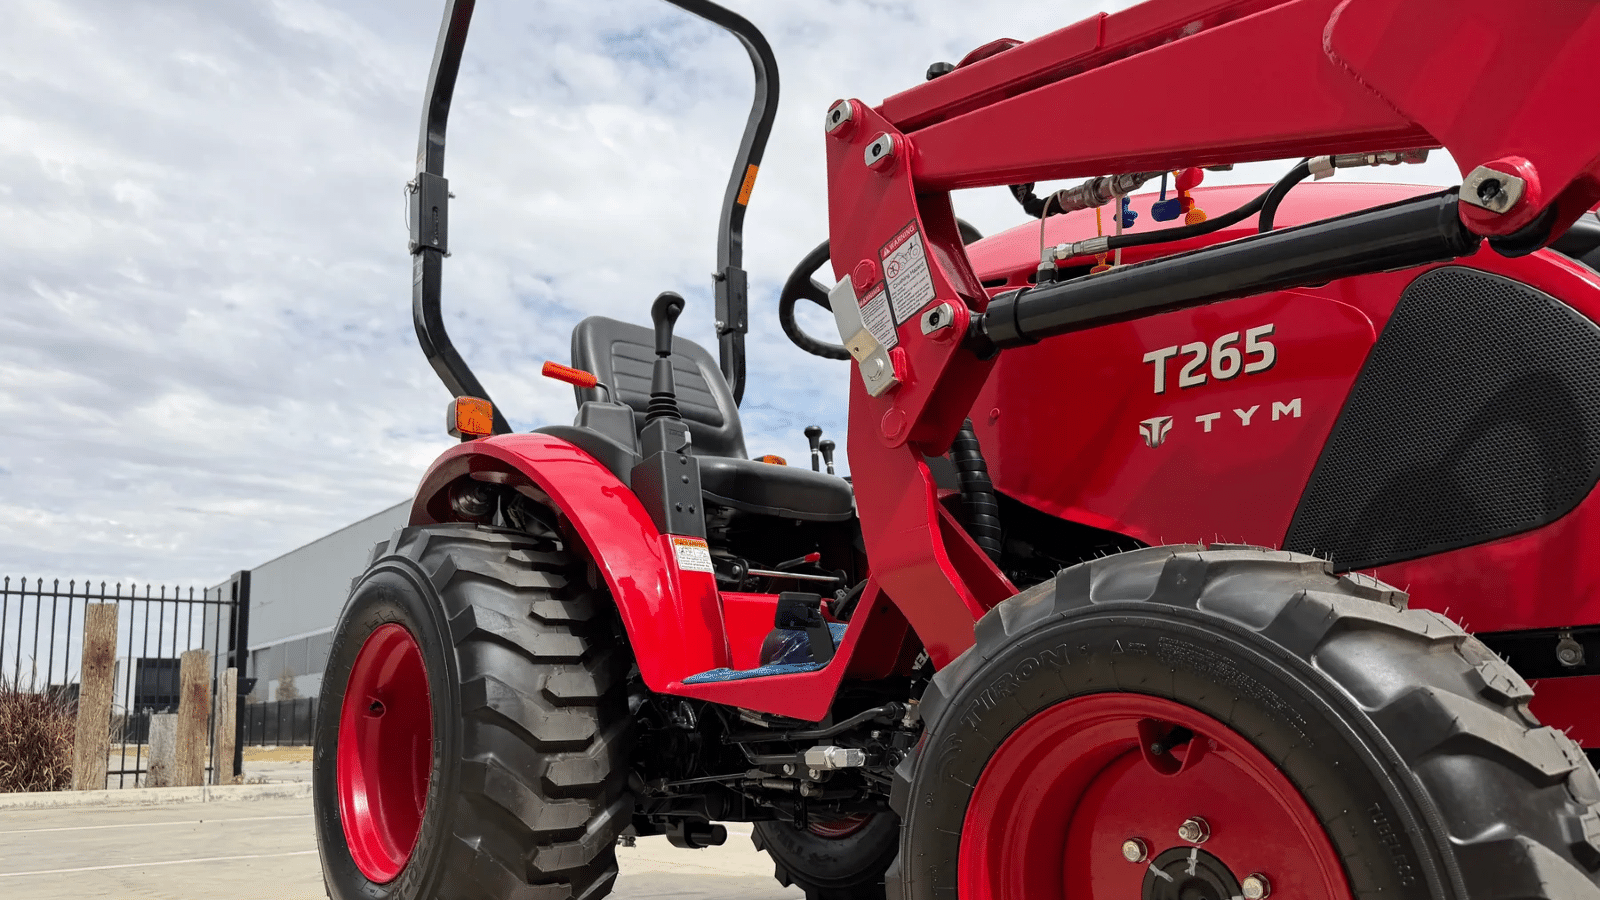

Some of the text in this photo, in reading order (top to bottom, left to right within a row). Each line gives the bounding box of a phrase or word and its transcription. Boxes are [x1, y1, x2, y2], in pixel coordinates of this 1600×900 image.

[889, 225, 915, 250] WARNING
[1142, 323, 1277, 395] T265
[1195, 397, 1302, 433] TYM
[960, 643, 1071, 729] TIRON
